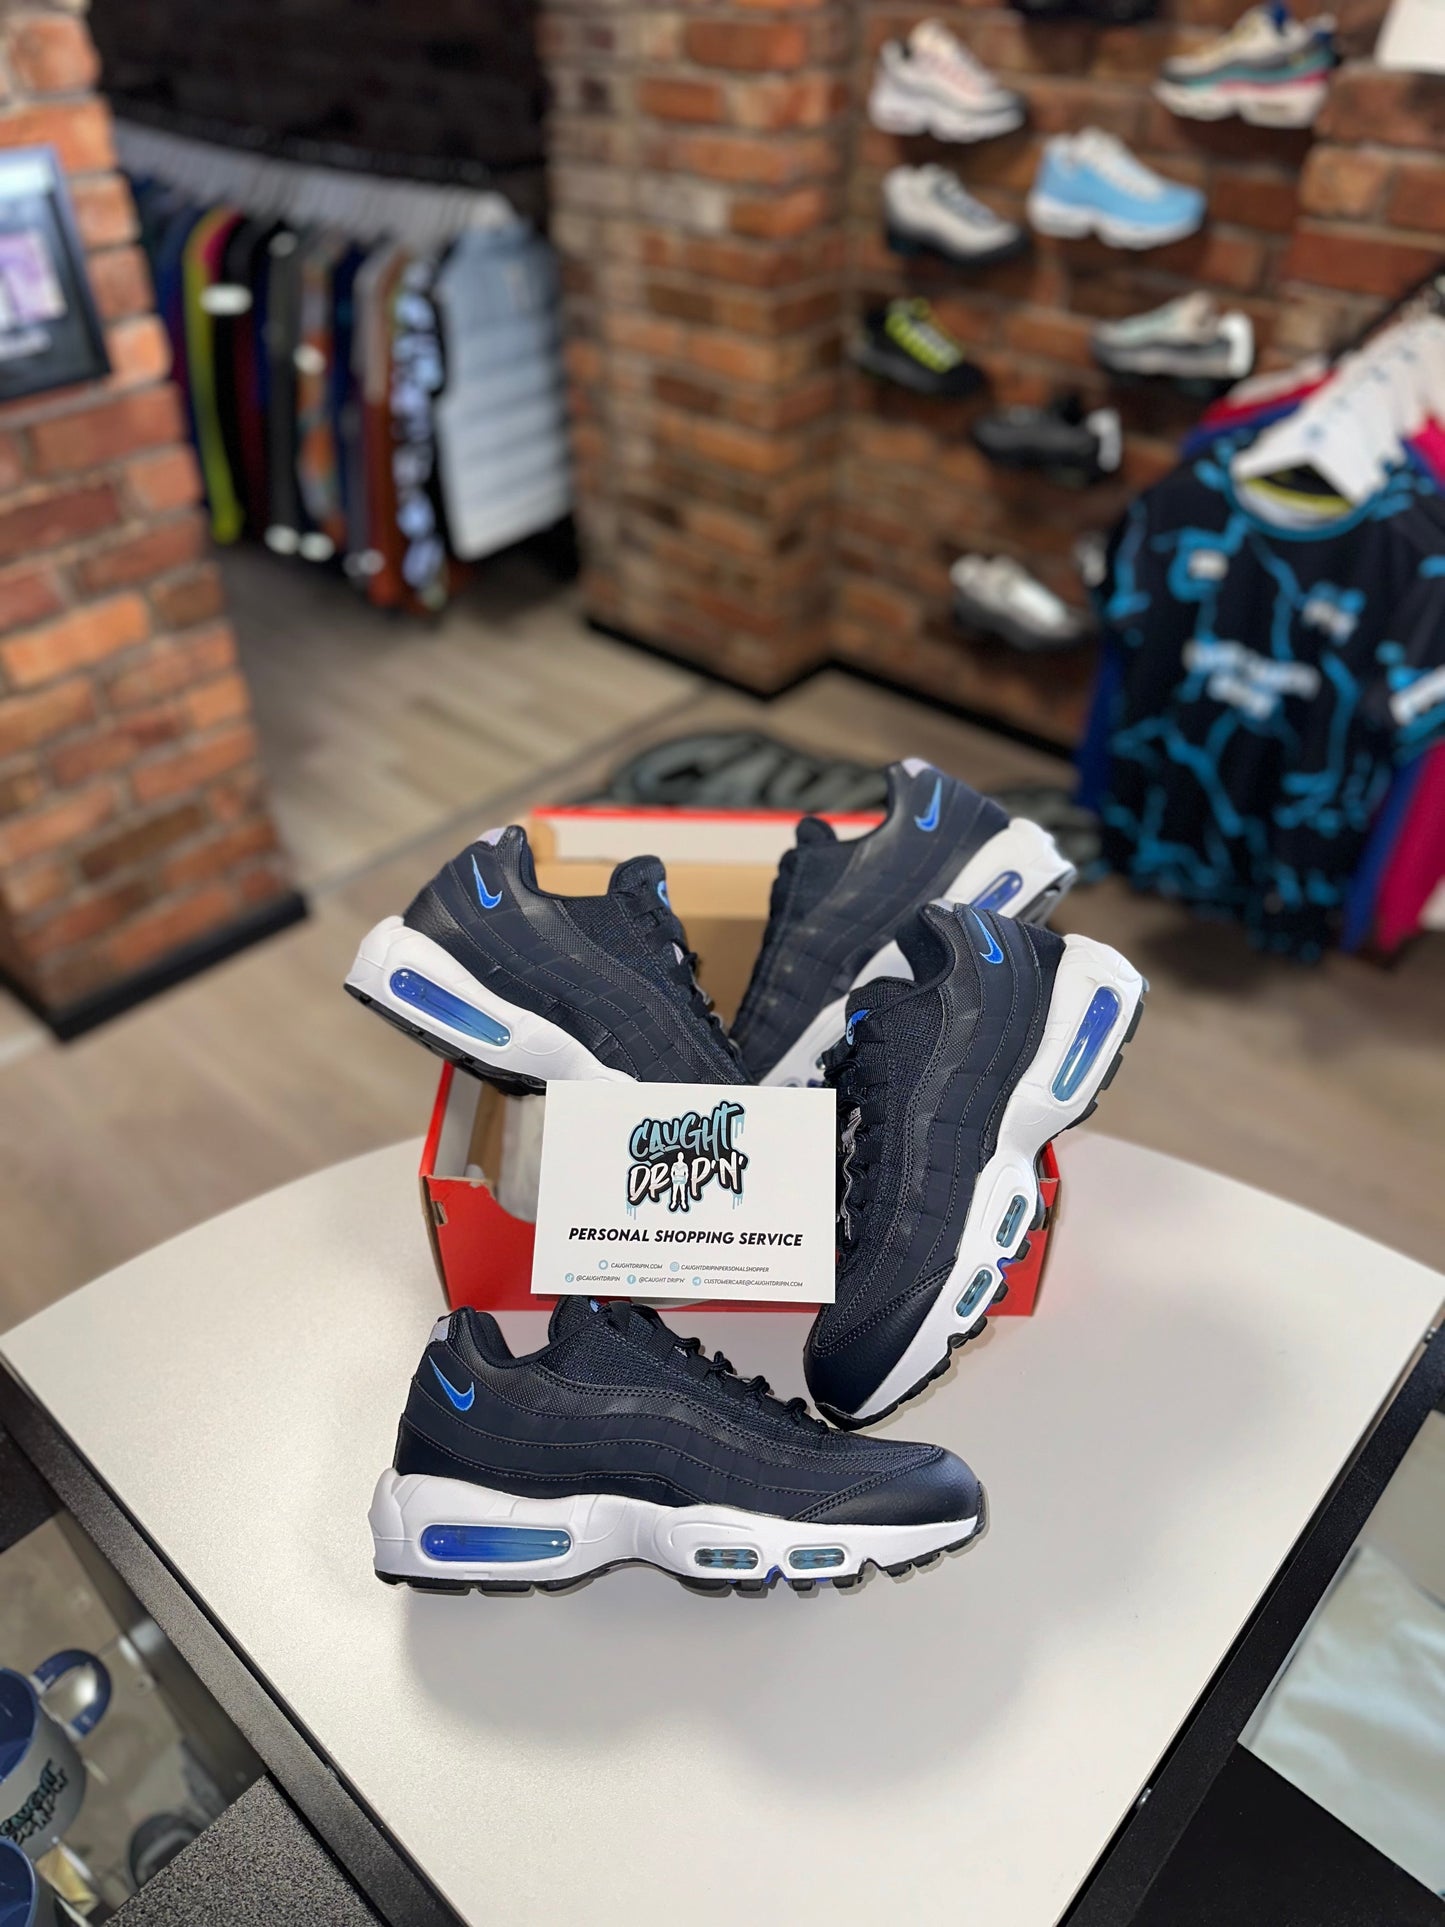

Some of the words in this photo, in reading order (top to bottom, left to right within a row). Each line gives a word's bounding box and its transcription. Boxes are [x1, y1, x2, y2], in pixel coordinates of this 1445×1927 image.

[629, 1101, 744, 1161] CAUGHT
[568, 1227, 650, 1242] PERSONAL
[654, 1230, 735, 1245] SHOPPING
[738, 1232, 803, 1247] SERVICE
[610, 1262, 663, 1270] CAUGHTDRIPIN.COM
